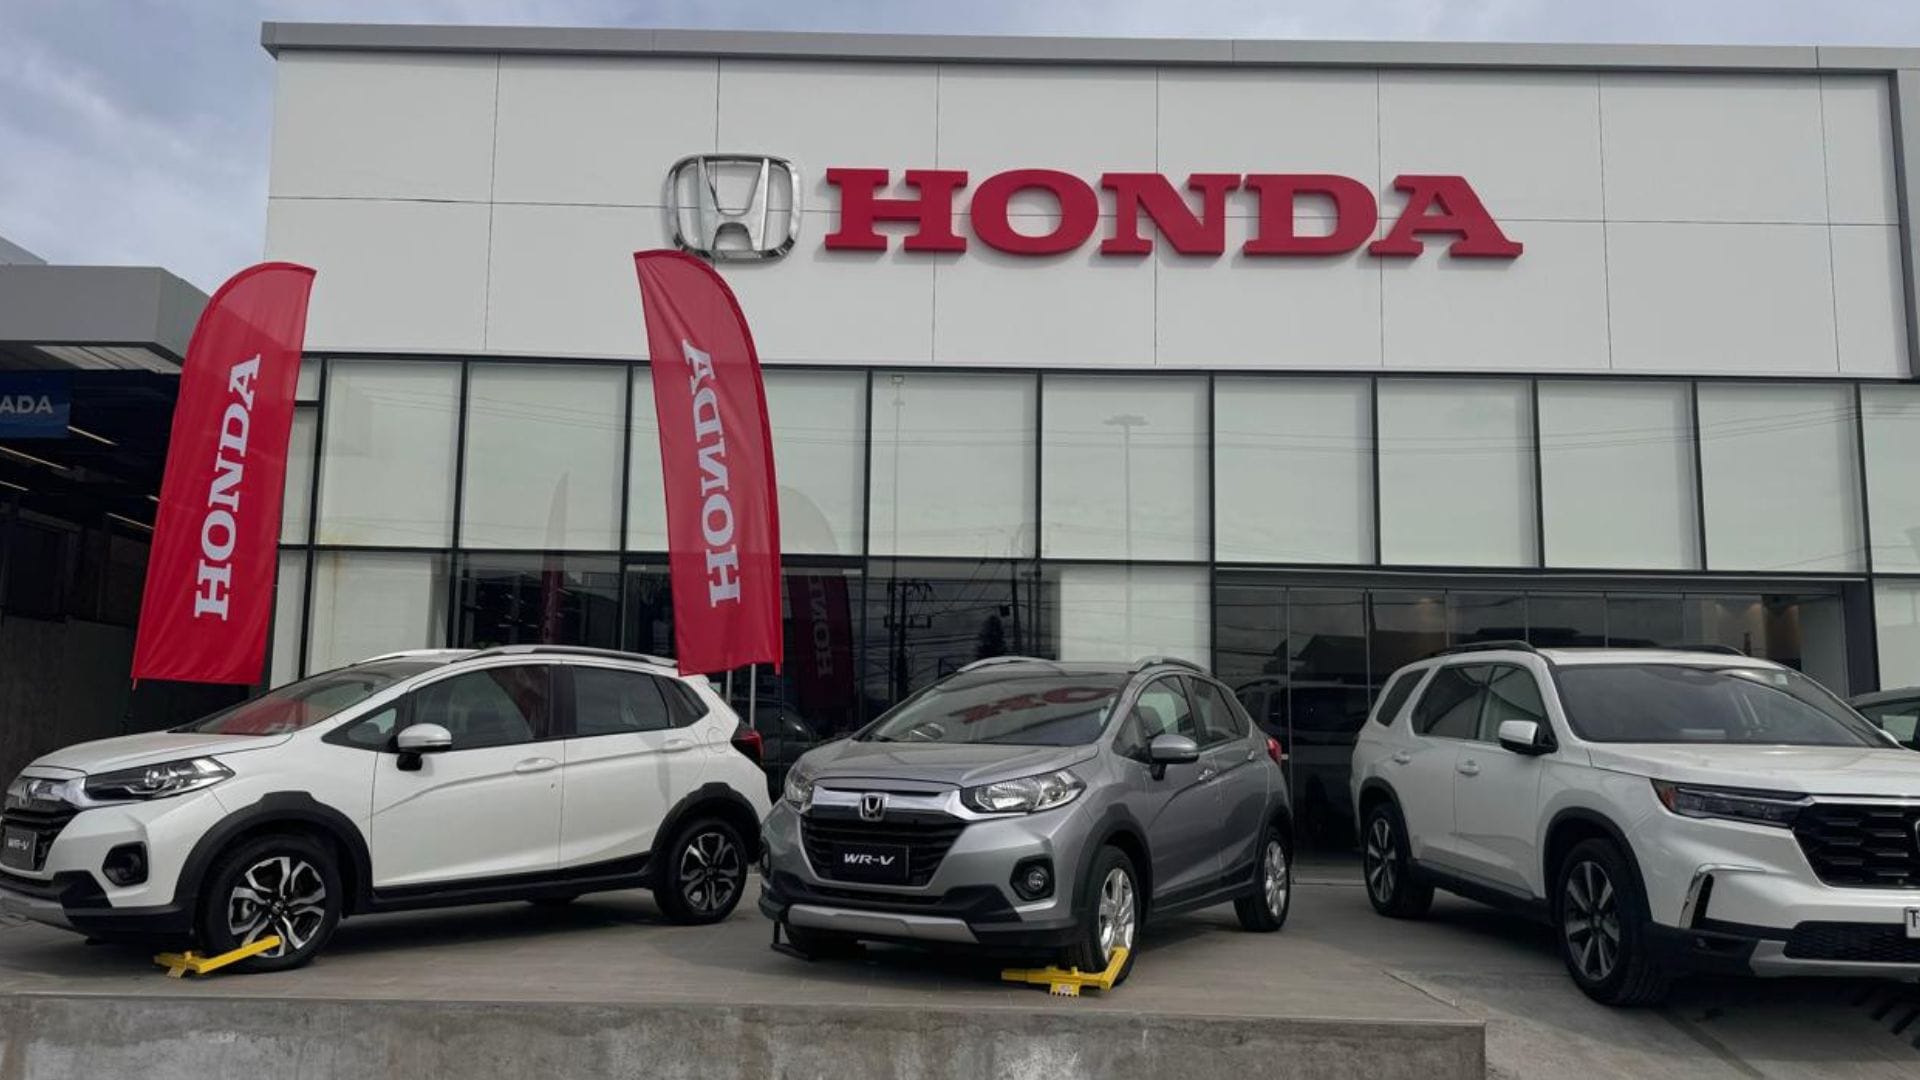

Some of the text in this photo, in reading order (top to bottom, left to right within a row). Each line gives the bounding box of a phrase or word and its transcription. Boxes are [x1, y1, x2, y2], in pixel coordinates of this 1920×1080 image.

[825, 167, 1522, 258] HONDA
[0, 395, 53, 414] ADA
[194, 354, 260, 621] HONDA
[844, 853, 896, 866] WR-V
[1909, 909, 1920, 928] T
